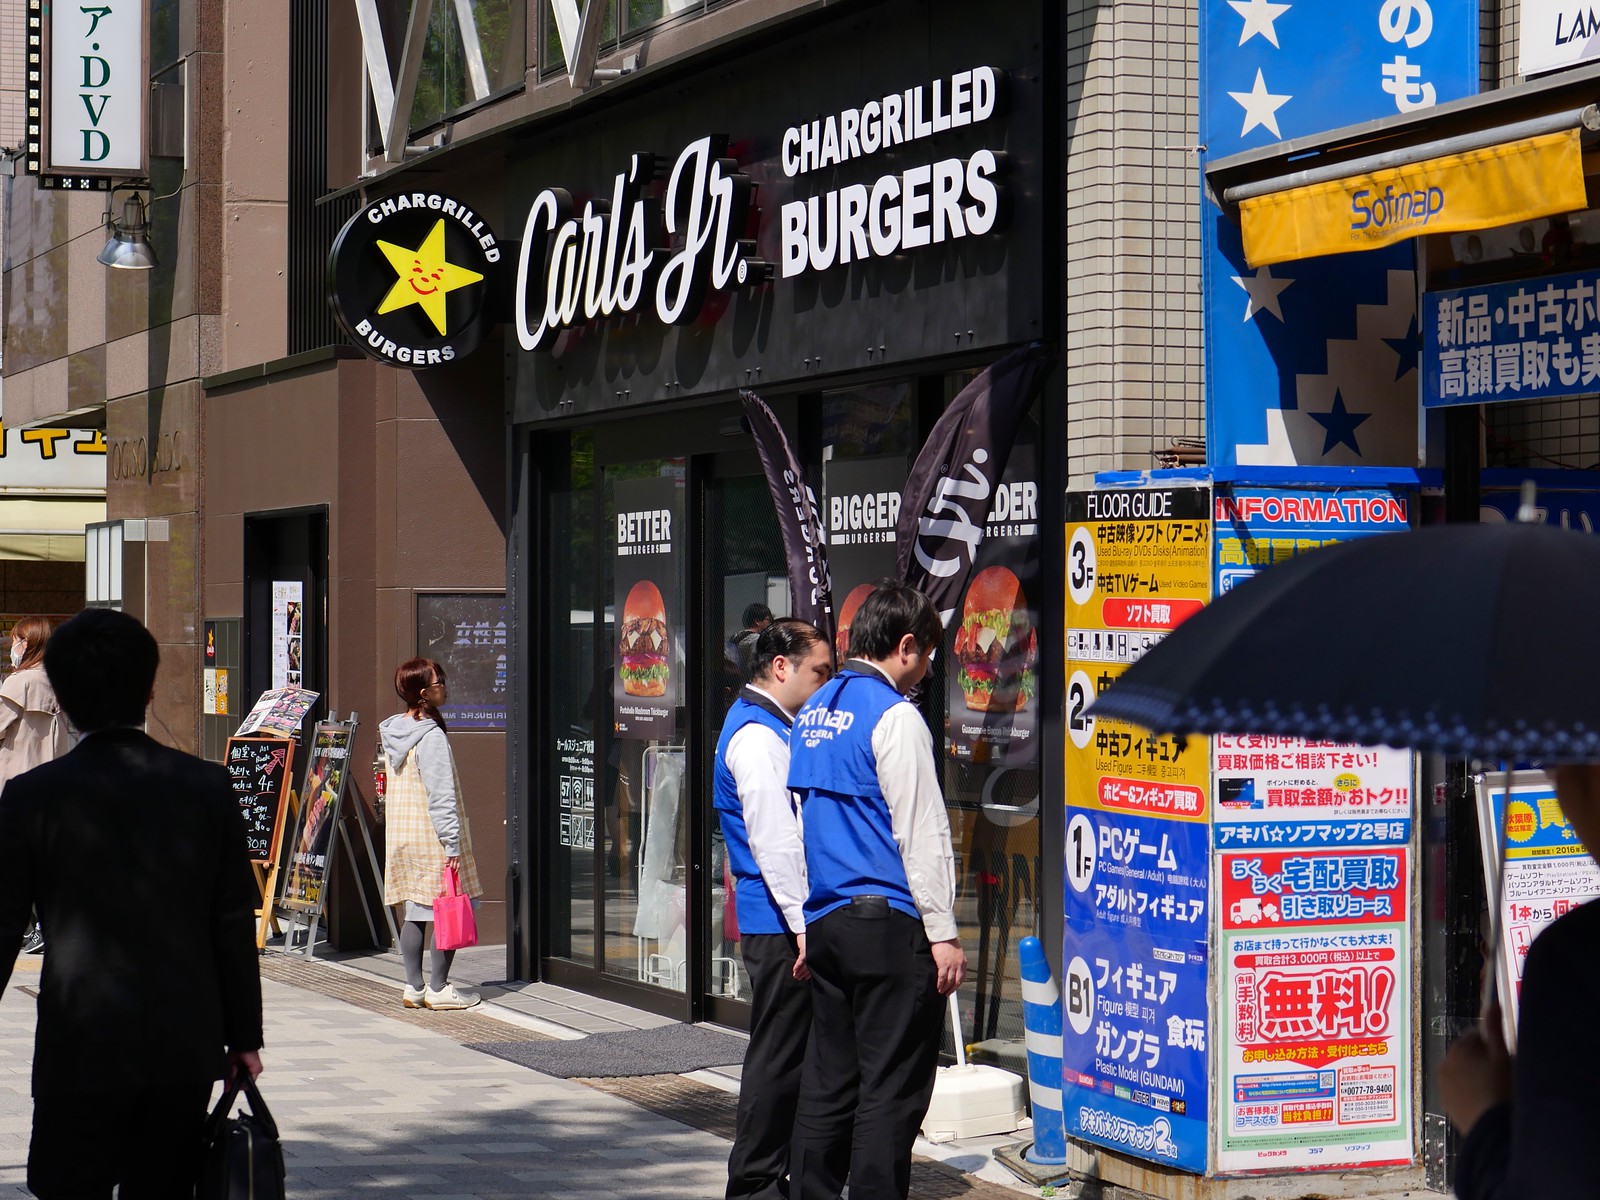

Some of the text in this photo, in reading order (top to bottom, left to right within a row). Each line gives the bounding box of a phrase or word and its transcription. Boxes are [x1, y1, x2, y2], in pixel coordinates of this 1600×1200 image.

[782, 65, 996, 178] CHARGRILLED
[782, 149, 998, 279] BURGERS
[1350, 185, 1445, 230] Sofmap
[367, 193, 501, 263] CHARGRILLED
[516, 154, 653, 351] Carl's
[355, 318, 456, 365] BURGERS
[831, 491, 901, 531] BIGGER
[1087, 492, 1172, 518] FLOOR GUIDE
[1215, 496, 1407, 524] INFORMATION
[618, 509, 672, 543] BETTER
[845, 531, 887, 545] BURGERS
[629, 544, 660, 555] BURGERS
[1097, 573, 1159, 593] 中古TVゲーム
[1126, 604, 1171, 624] ソフト買取
[1095, 758, 1112, 772] Used
[1113, 760, 1133, 776] Figure
[1218, 752, 1378, 771] 買取価格ご相談下さい！
[1103, 782, 1198, 811] ホビー&フィギュア買取
[1098, 825, 1178, 872] PCゲーム
[1282, 856, 1399, 892] 宅配買取
[1095, 884, 1205, 924] アダルトフィギュア
[1281, 894, 1392, 920] 引き取りコース
[1069, 973, 1091, 1018] B1
[1096, 957, 1177, 1005] フィギュア
[1097, 995, 1123, 1016] Figure
[1125, 1001, 1140, 1018] 模型
[1095, 1020, 1160, 1069] ガンプラ
[1166, 1015, 1205, 1052] 食玩
[1096, 1058, 1118, 1076] Plastic
[1118, 1064, 1139, 1084] Model
[1140, 1071, 1185, 1096] (GUNDAM)
[1347, 1085, 1392, 1096] 0077-78-9400
